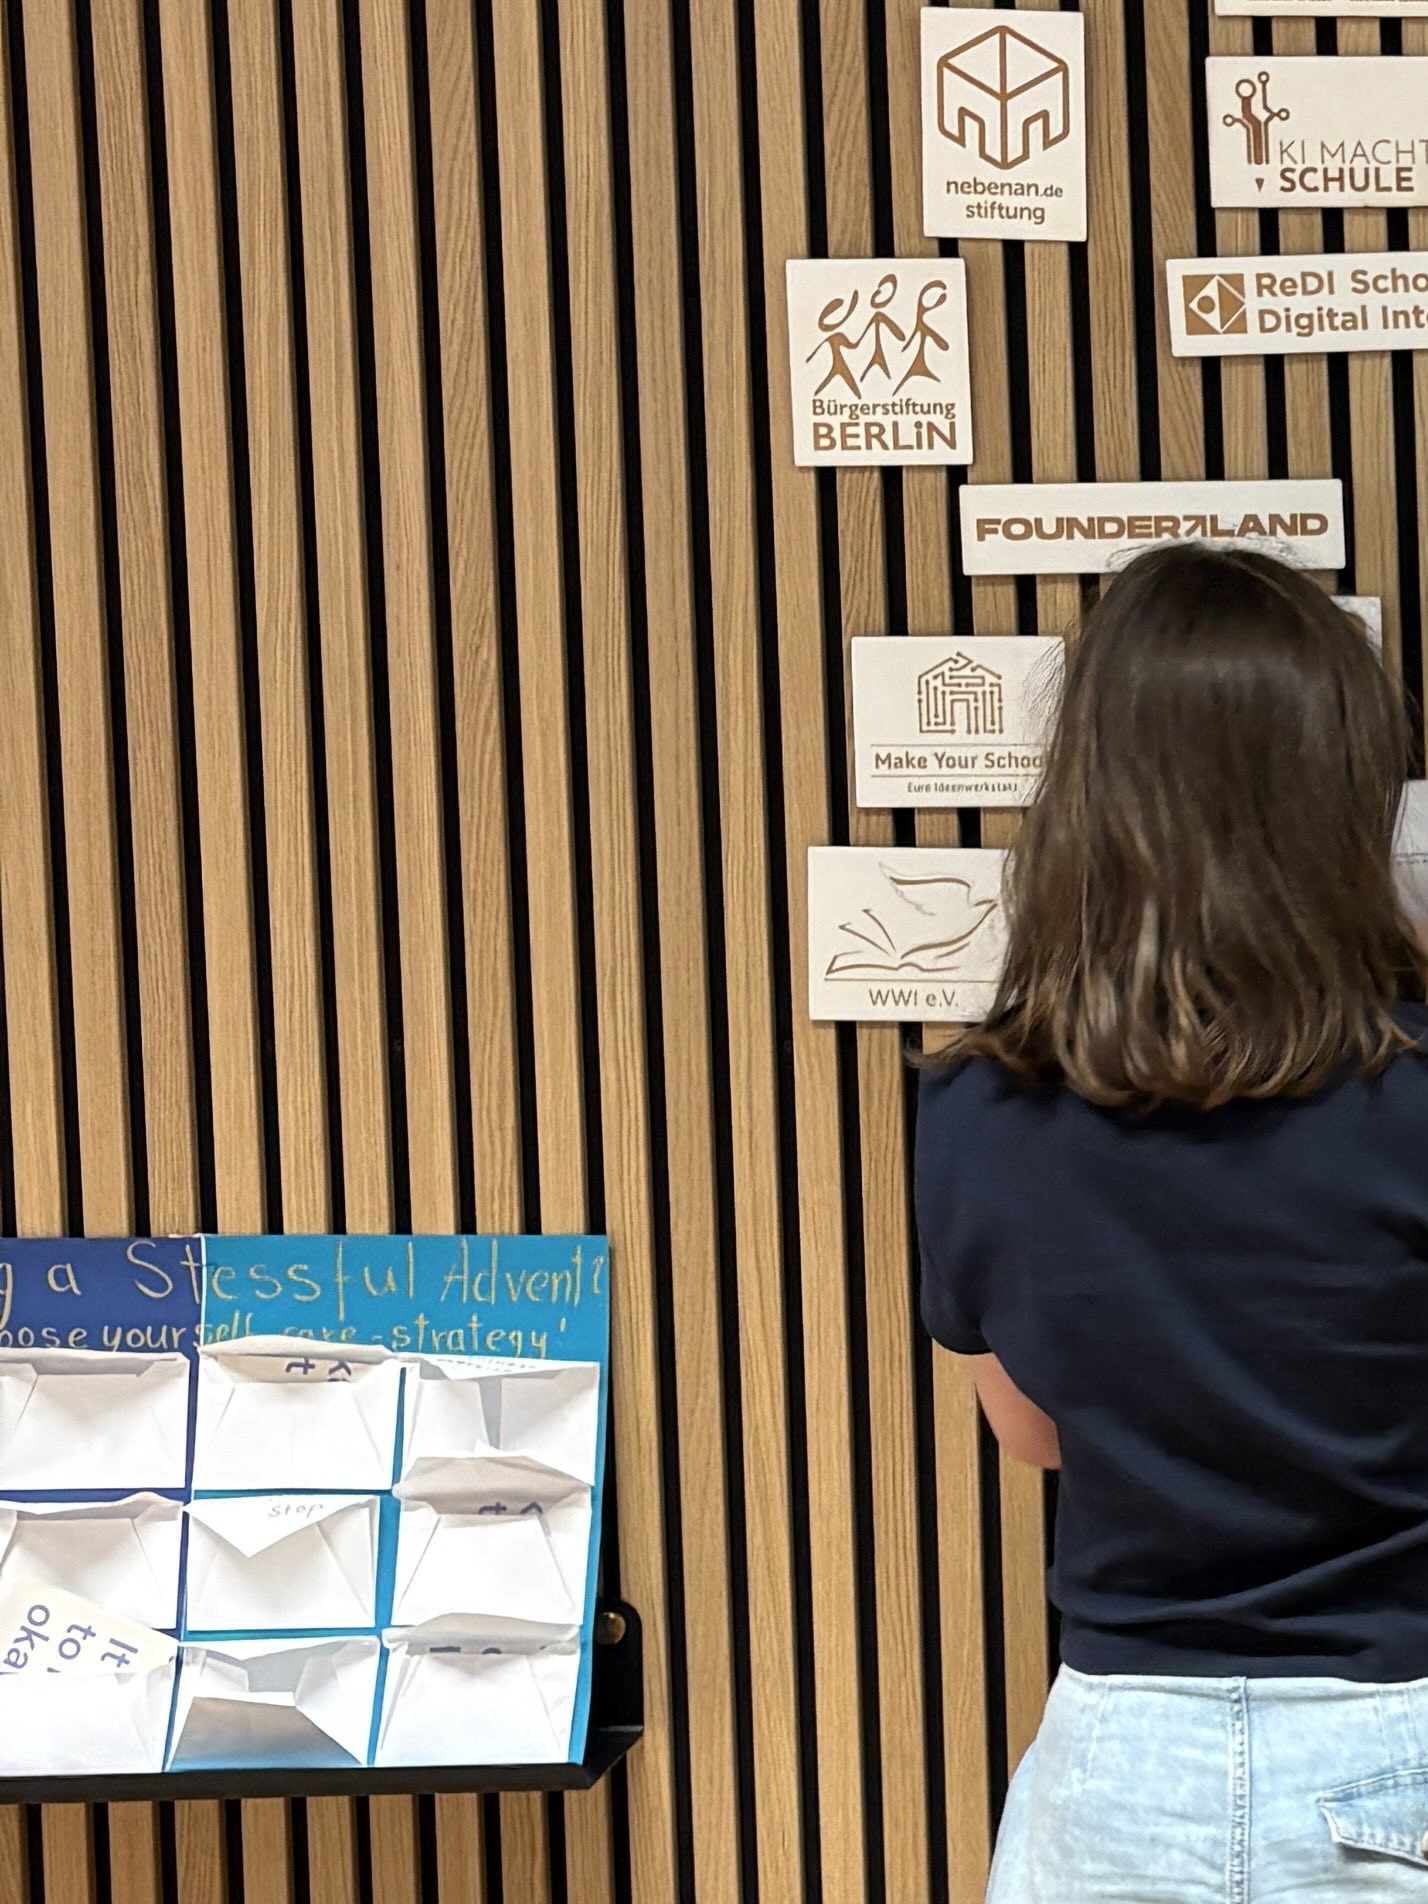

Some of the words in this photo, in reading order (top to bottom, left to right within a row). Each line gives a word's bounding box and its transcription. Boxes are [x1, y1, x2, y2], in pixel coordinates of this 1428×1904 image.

[1279, 140, 1305, 166] KI
[945, 177, 1064, 199] nebenan.de
[1279, 167, 1415, 194] SCHULE
[965, 201, 1046, 225] stiftung
[1255, 271, 1336, 299] ReDI
[1258, 305, 1369, 338] Digital
[812, 397, 956, 420] Bürgerstiftung
[874, 751, 928, 770] Make
[934, 751, 978, 769] Your
[984, 751, 1043, 769] Schoo
[926, 988, 960, 1007] e.V.
[47, 1263, 82, 1296] a
[1, 1603, 51, 1674] oka
